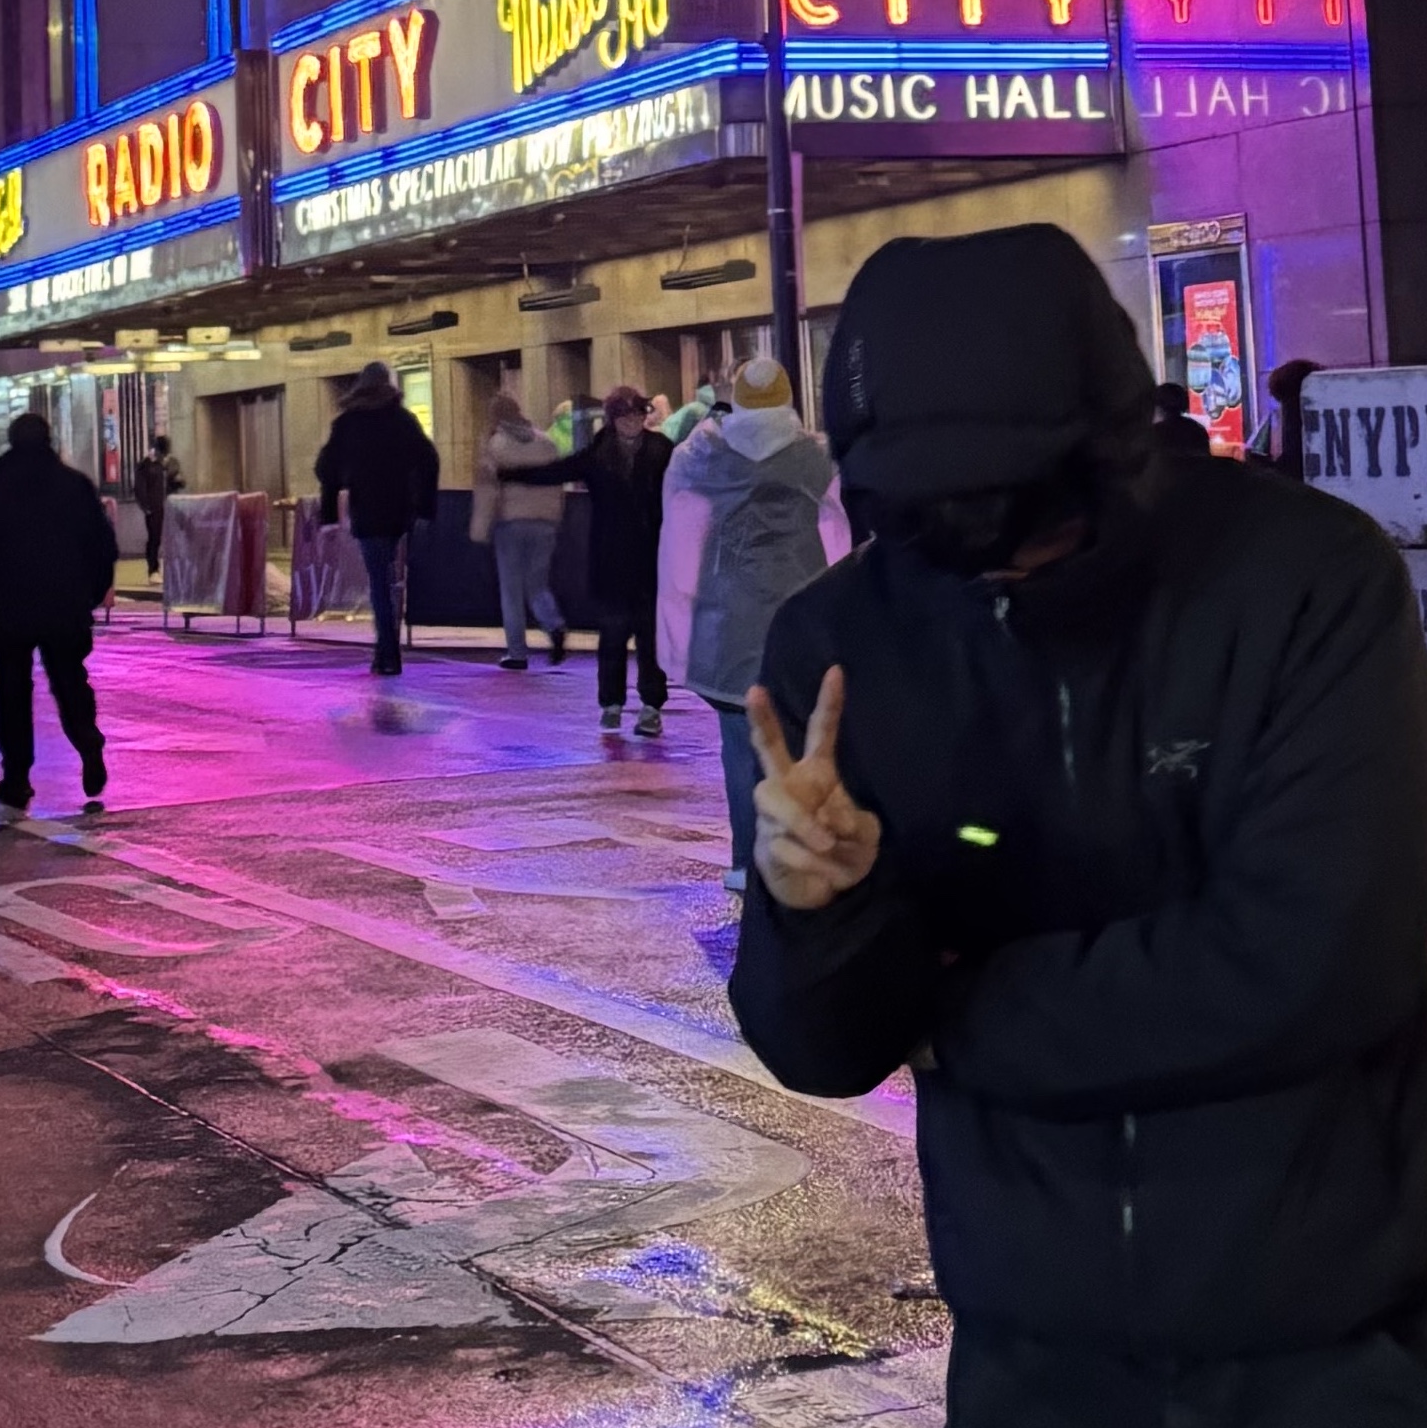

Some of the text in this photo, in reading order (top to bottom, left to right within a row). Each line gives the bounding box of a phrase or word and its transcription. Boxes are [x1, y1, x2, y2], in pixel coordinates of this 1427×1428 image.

[287, 5, 426, 156] CITY
[784, 73, 1107, 121] MUSIC HALL
[85, 99, 214, 228] RADIO
[294, 178, 383, 236] CHRISTMAS
[388, 137, 517, 211] SPECTACULAR
[525, 118, 583, 171] NOW
